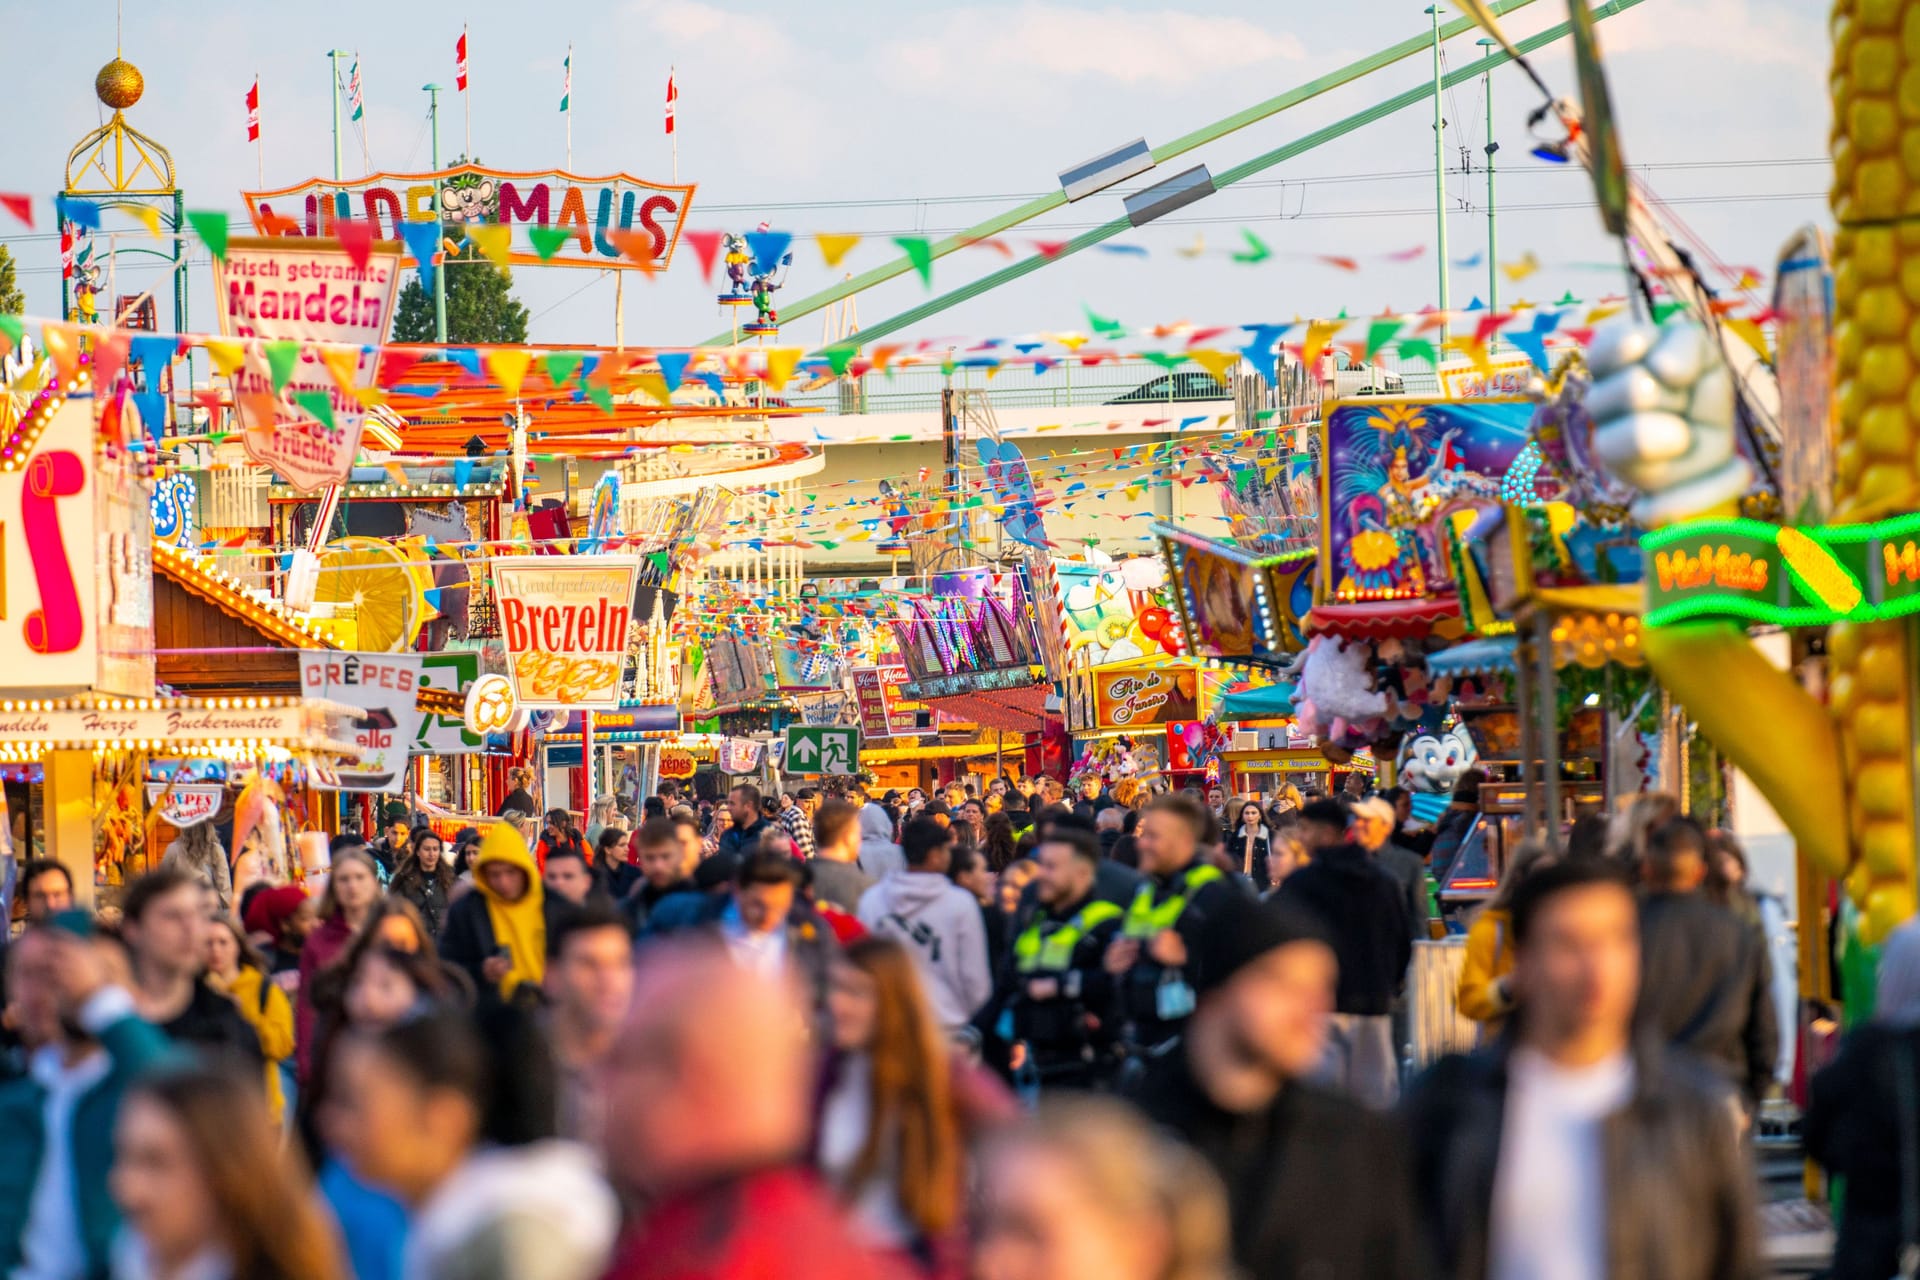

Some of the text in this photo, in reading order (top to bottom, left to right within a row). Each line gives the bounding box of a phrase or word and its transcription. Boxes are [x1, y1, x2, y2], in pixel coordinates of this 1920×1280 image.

[498, 182, 677, 258] MAUS
[228, 280, 382, 329] Mandeln
[501, 597, 628, 652] Brezeln
[305, 654, 414, 693] CRÊPES
[1109, 671, 1161, 699] Rio de
[593, 711, 635, 730] Kasse
[1113, 693, 1168, 723] Janeiro
[82, 713, 137, 736] Herze
[166, 711, 283, 735] Zuckerwatte
[356, 729, 392, 748] ella
[661, 754, 691, 774] rêpes
